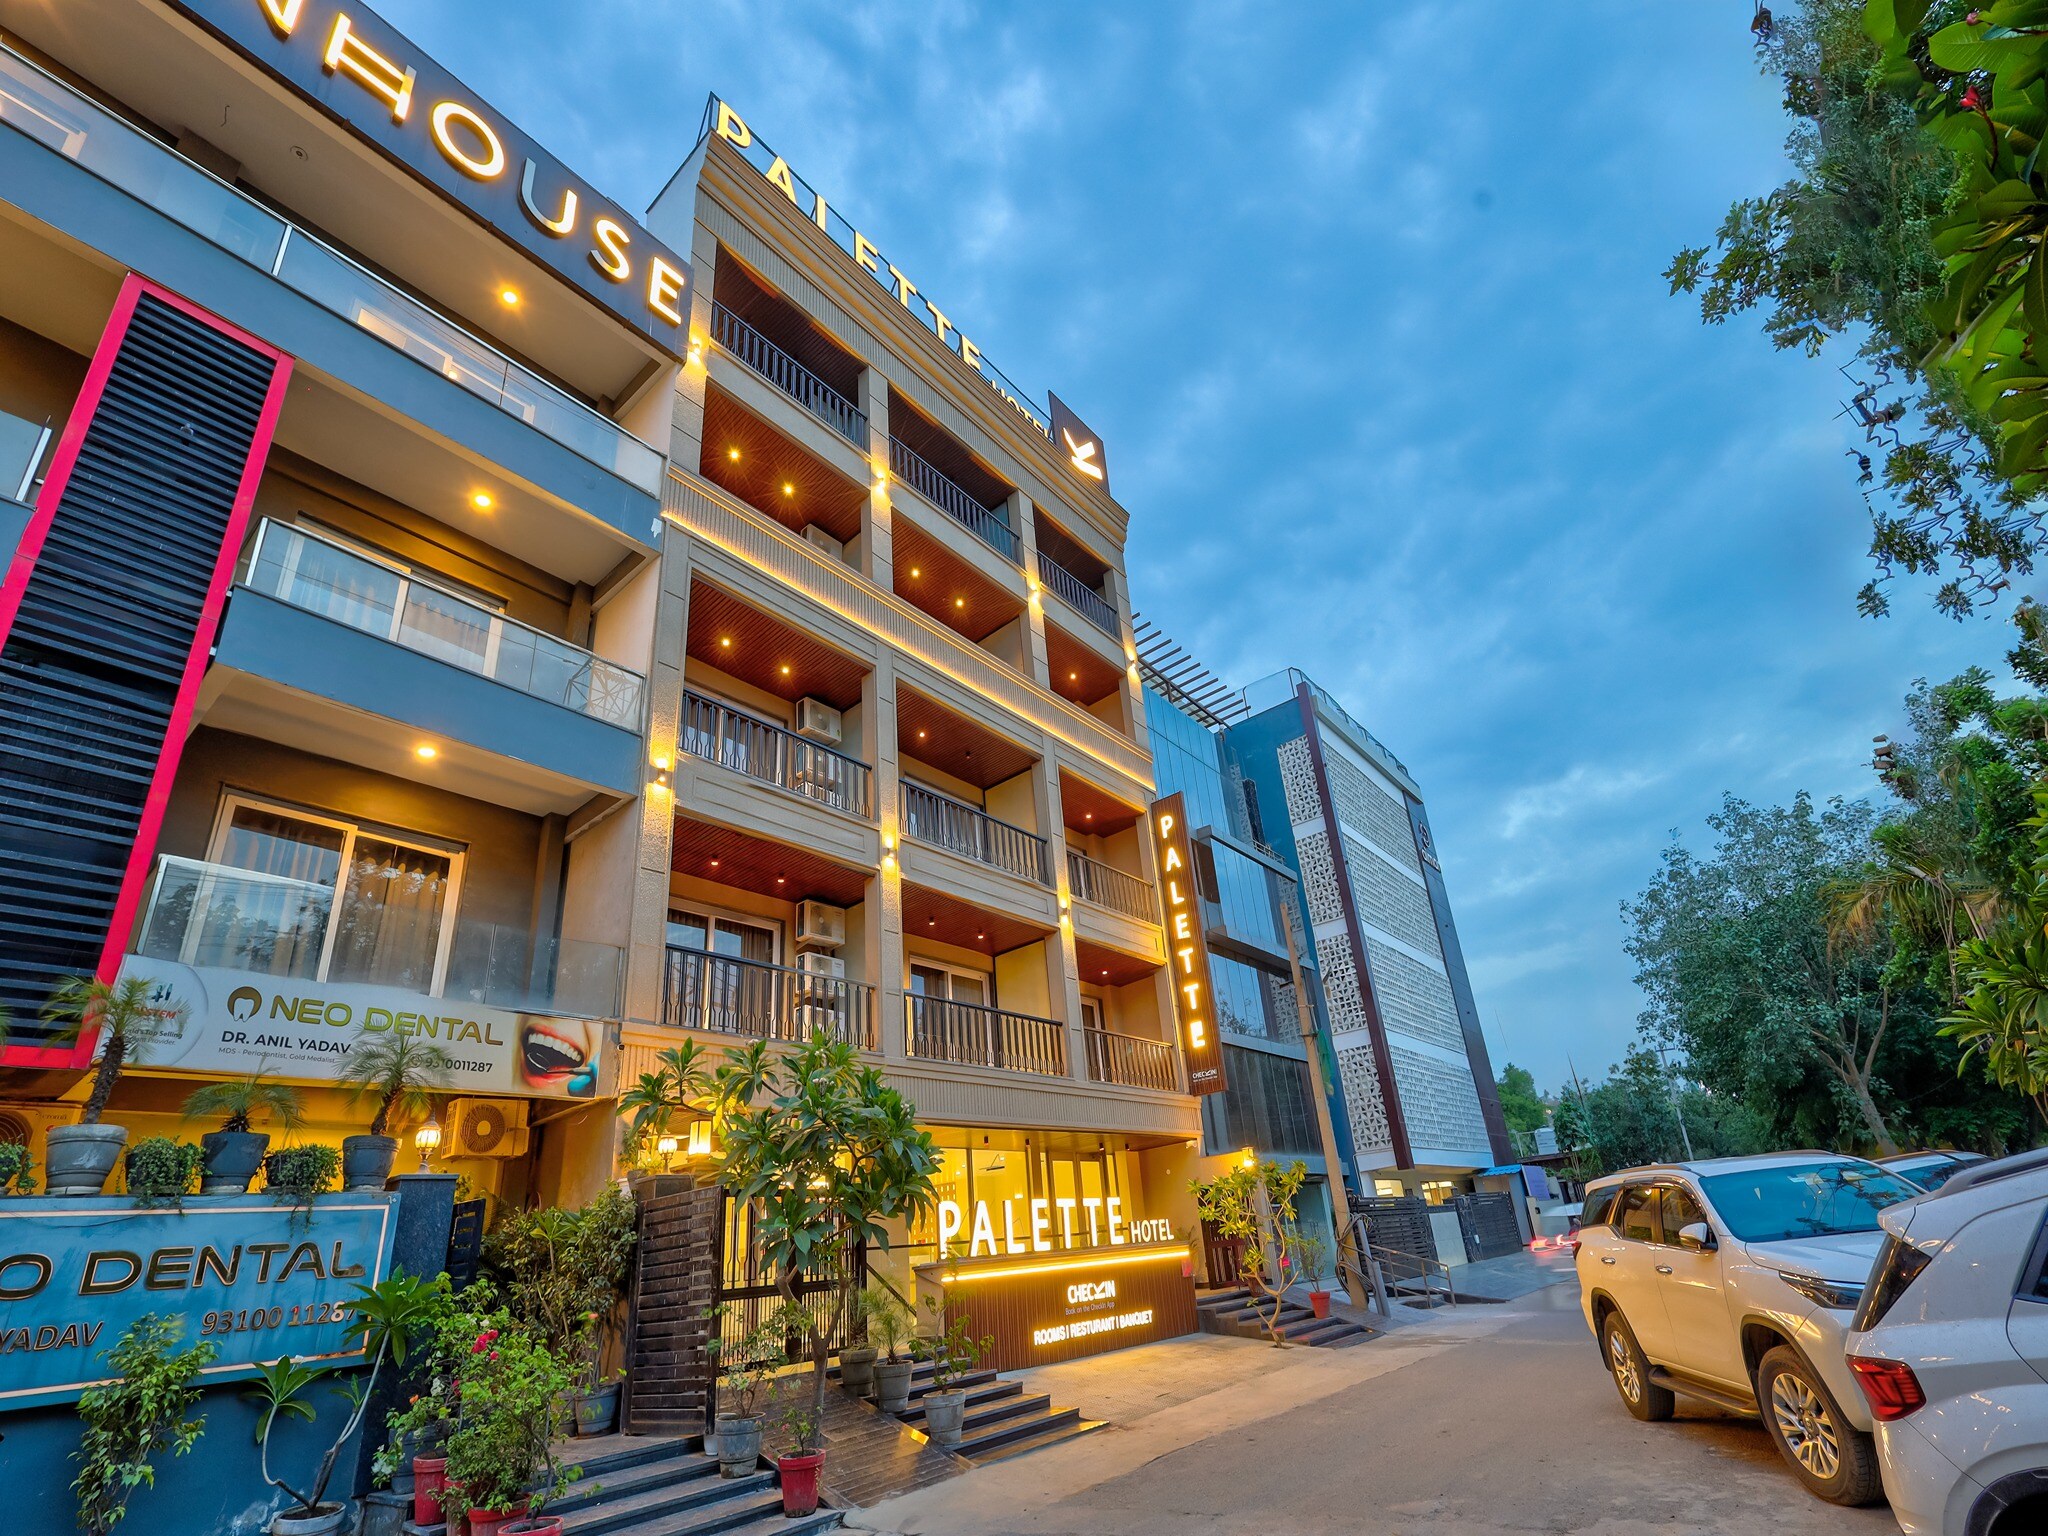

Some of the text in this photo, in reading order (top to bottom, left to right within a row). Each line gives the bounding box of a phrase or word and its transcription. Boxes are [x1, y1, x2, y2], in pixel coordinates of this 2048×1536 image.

[1160, 815, 1205, 1048] PALETTE
[159, 1030, 183, 1040] Selling
[269, 994, 503, 1046] NEO DENTAL
[218, 1047, 237, 1055] MDS
[242, 1049, 287, 1060] Periodontist,
[289, 1053, 306, 1061] Gold
[306, 1055, 336, 1064] Medalist
[221, 1030, 352, 1054] DR. ANIL YADAV
[938, 1197, 1175, 1260] PALETTE HOTEL
[78, 1239, 366, 1296] DENTAL
[201, 1306, 283, 1336] 93100
[1033, 1325, 1066, 1346] ROOMS
[1070, 1315, 1115, 1338] RESTURANT
[1120, 1309, 1153, 1329] BANQUET
[1065, 1306, 1076, 1316] Book
